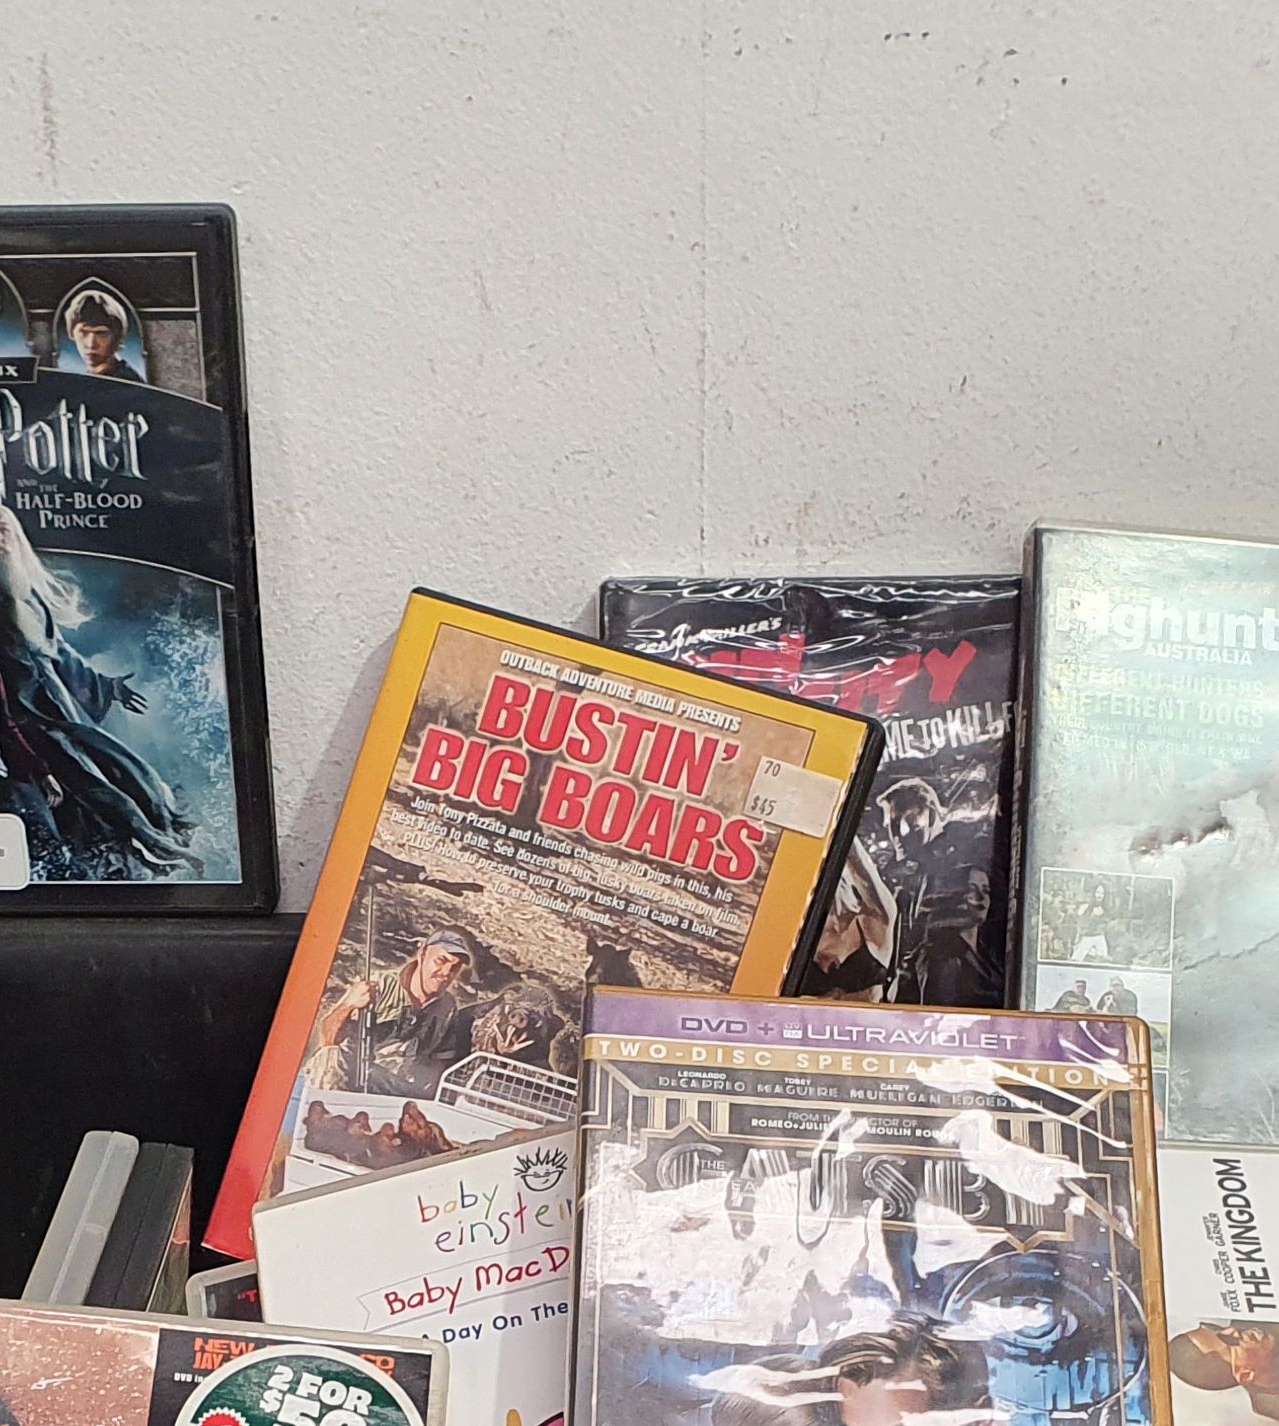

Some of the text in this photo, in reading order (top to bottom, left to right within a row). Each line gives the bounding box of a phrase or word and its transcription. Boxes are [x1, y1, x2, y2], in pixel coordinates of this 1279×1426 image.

[15, 491, 143, 511] HALF-BLOOD
[39, 510, 110, 529] PRINCE
[1143, 640, 1254, 665] AUSTRALIA
[499, 648, 742, 733] OUTBACK ADVENTURE MEDIA PRESENTS
[1198, 700, 1265, 729] DOGS
[477, 673, 742, 797] BUSTIN'
[763, 760, 782, 778] 70
[411, 725, 767, 886] BIG BOARS
[750, 794, 776, 817] $45
[410, 795, 436, 814] Join
[437, 803, 466, 824] Tony
[465, 812, 508, 836] Pizzata
[507, 825, 532, 843] and
[532, 832, 573, 855] friends
[572, 845, 619, 871] chasing
[645, 866, 673, 887] pigs
[673, 875, 686, 889] in
[686, 878, 715, 899] this,
[714, 886, 734, 903] his
[449, 826, 463, 841] to
[462, 830, 493, 851] date.
[492, 840, 516, 858] See
[516, 847, 559, 871] dozens
[403, 830, 719, 938] PLUS! preserve your trophy tusks and cape a boar
[521, 888, 570, 914] shoulder
[680, 1017, 1019, 1051] DVD ULTRAVIOLET
[599, 1039, 773, 1066] TWO-DISC
[677, 1070, 727, 1081] LEONARDO
[756, 1083, 941, 1105] MAGUIRE MULLIGAN
[787, 1112, 821, 1122] FROM
[866, 1125, 912, 1137] MOULIN
[698, 1159, 726, 1171] THE
[416, 1180, 499, 1224] baby
[434, 1191, 573, 1253] einstei
[1208, 1212, 1226, 1247] GARNER
[1212, 1157, 1277, 1314] THE KINGDOM
[1217, 1251, 1235, 1285] COOPER
[383, 1275, 463, 1316] Baby
[442, 1301, 569, 1344] Day On The
[268, 1364, 373, 1416] 2 FOR
